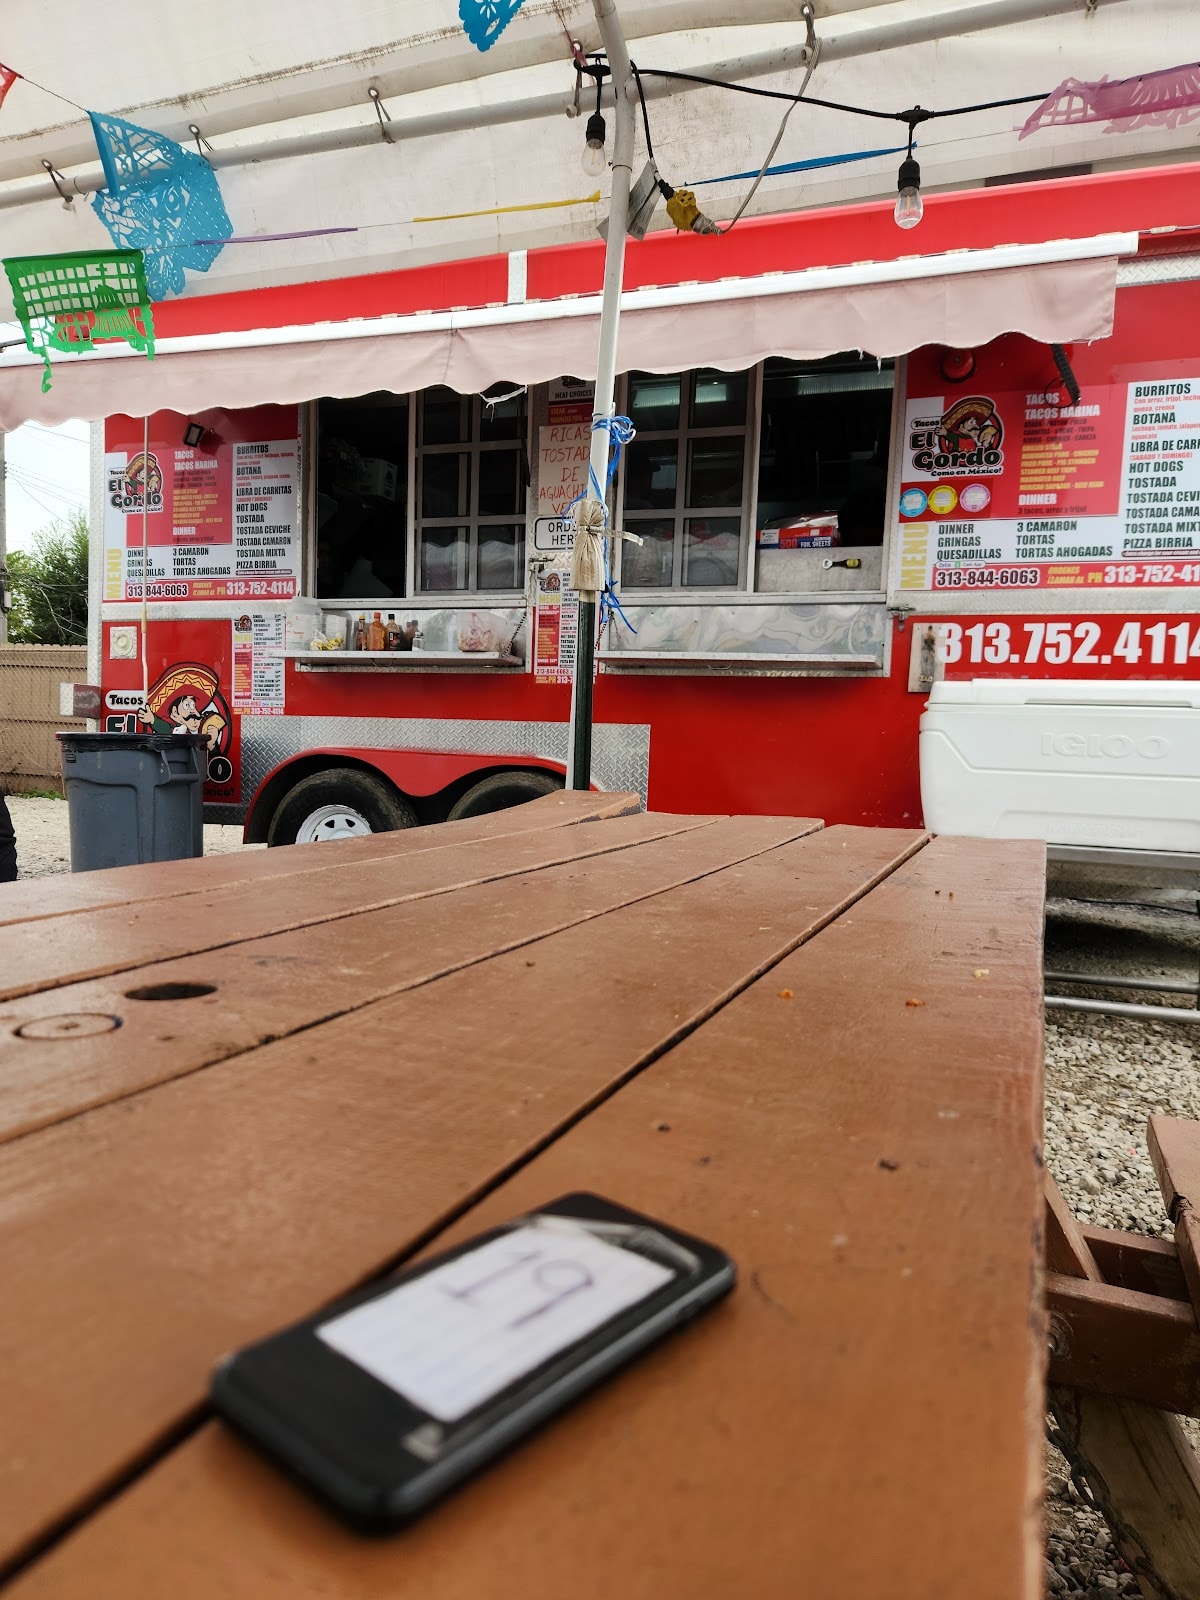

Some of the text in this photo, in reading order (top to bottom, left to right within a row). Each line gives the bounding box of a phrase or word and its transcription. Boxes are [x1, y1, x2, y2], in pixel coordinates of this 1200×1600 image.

[1136, 383, 1190, 397] BURRITOS
[1026, 393, 1059, 405] TACOS
[1024, 408, 1058, 419] TACOS
[1133, 413, 1175, 424] BOTANA
[551, 426, 591, 442] RICAS
[911, 431, 935, 448] El
[237, 445, 269, 454] BURRITOS
[1131, 441, 1159, 452] LIBRA
[1162, 440, 1174, 450] DE
[174, 450, 194, 459] TACOS
[542, 446, 590, 462] TOSTAD
[914, 448, 1000, 470] Gordo
[174, 462, 193, 470] TACOS
[237, 467, 261, 475] BOTANA
[1129, 461, 1183, 473] HOT DOGS
[562, 467, 580, 481] DE
[109, 479, 122, 491] El
[1129, 477, 1176, 488] TOSTADA
[237, 488, 252, 496] LIBRA
[263, 486, 291, 495] CARNITAS
[112, 494, 161, 508] Gordo
[1019, 493, 1057, 505] DINNER
[1128, 491, 1200, 503] TOSTADA CEVI
[250, 503, 267, 511] DOGS
[1126, 507, 1200, 518] TOSTADA CAMA
[236, 515, 264, 523] TOSTADA
[173, 527, 195, 535] DINNER
[236, 525, 291, 535] TOSTADA CEVICHE
[939, 524, 974, 534] DINNER
[1017, 521, 1077, 532] 3 CAMARON
[1125, 523, 1172, 533] TOSTADA
[236, 537, 291, 546] TOSTADA CAMARON
[781, 539, 797, 548] 500
[938, 536, 981, 547] GRINGAS
[1017, 534, 1055, 545] TORTAS
[1124, 537, 1192, 548] PIZZA BIRRIA
[173, 548, 176, 556] 3
[266, 549, 285, 557] MIXTA
[901, 523, 928, 588] MENU
[937, 549, 1001, 561] QUESADILLAS
[1016, 548, 1054, 558] TORTAS
[1056, 546, 1113, 557] AHOGADAS
[237, 560, 276, 569] PIZZA BIRRIA
[107, 549, 122, 598] MENU
[173, 568, 196, 576] TORTAS
[197, 567, 230, 575] AHOGADAS
[937, 570, 1038, 585] 313-844-6063
[1088, 572, 1102, 583] PH
[129, 585, 187, 596] 313844-6063
[217, 587, 225, 595] PH
[227, 581, 294, 595] 313-752-4114
[109, 695, 143, 705] Tacos
[107, 716, 136, 733] El
[1041, 732, 1168, 759] IGLOO
